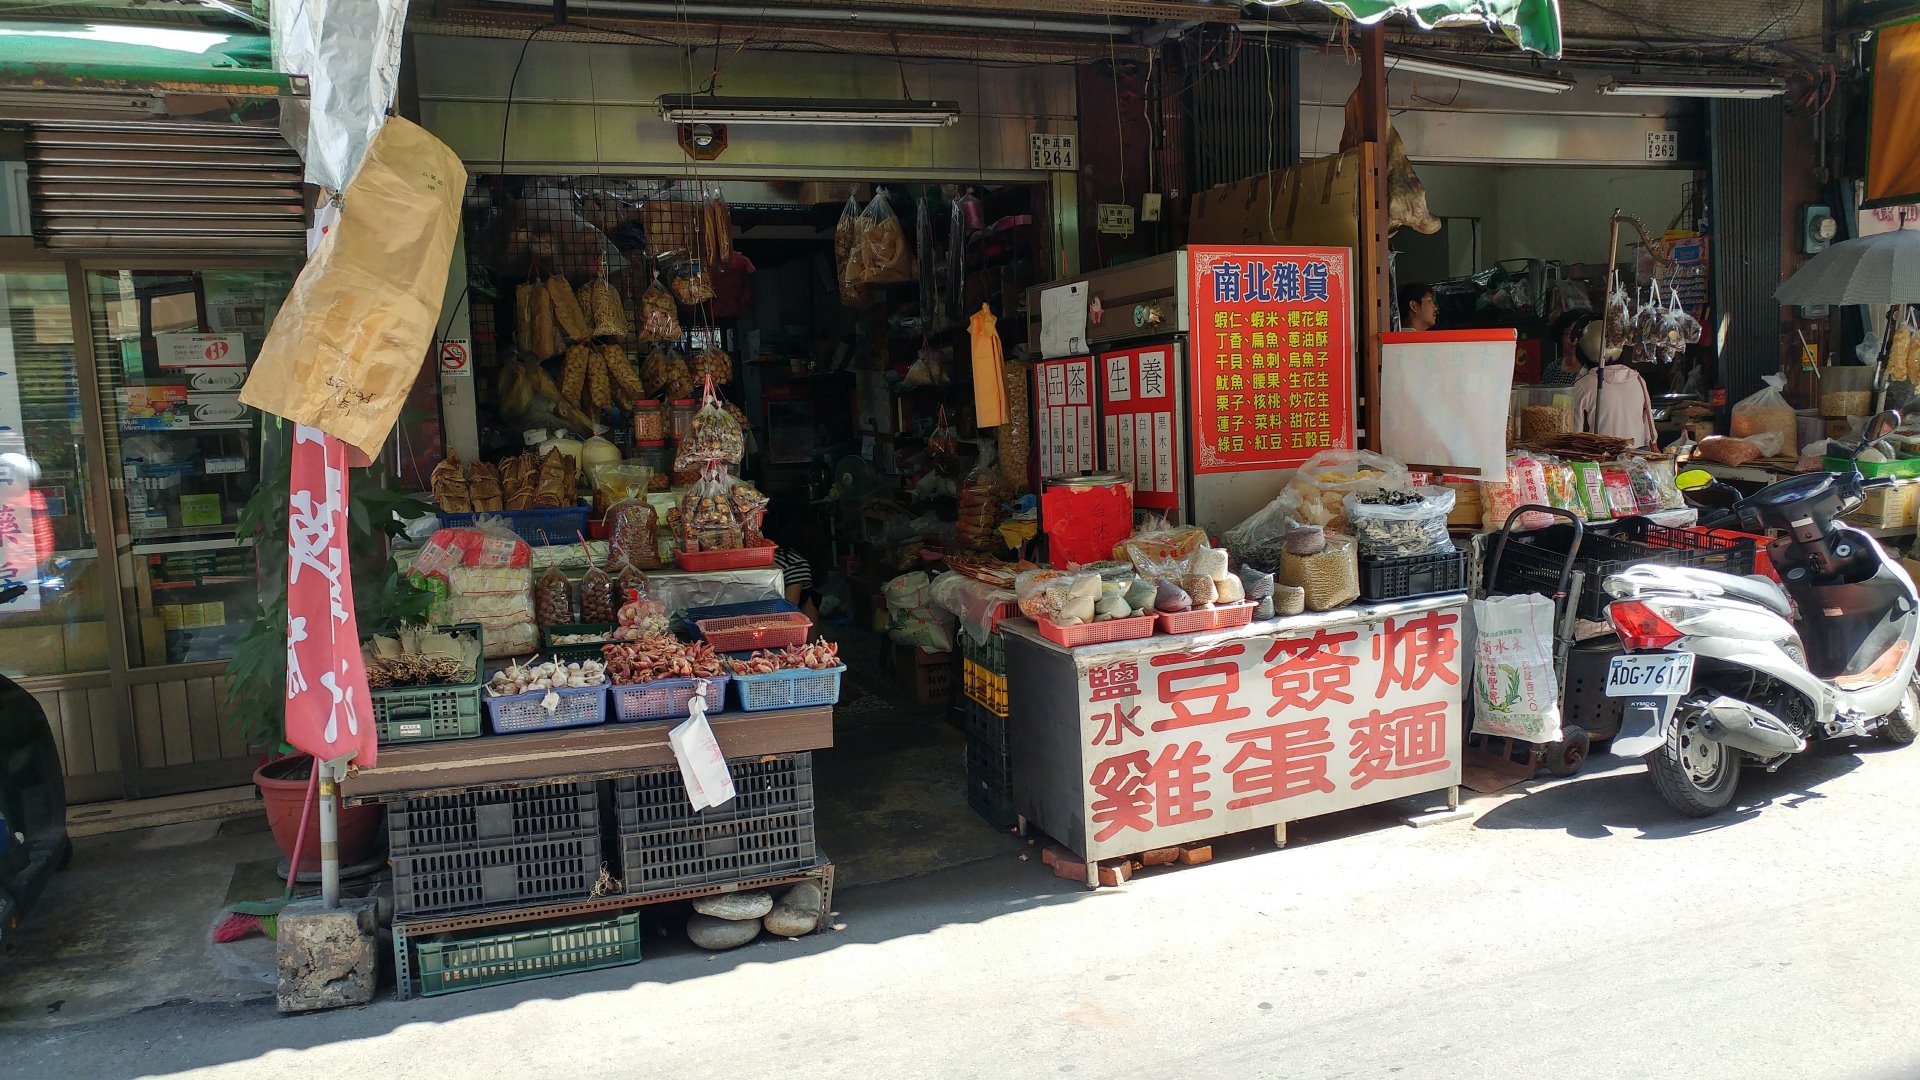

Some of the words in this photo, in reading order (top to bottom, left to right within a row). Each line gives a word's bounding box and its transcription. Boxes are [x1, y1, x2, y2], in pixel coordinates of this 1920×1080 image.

[1043, 150, 1072, 167] 264
[1654, 144, 1675, 157] 262
[1212, 261, 1330, 303] 南北雜貨
[1139, 417, 1149, 486] 白木耳茶
[1158, 416, 1168, 486] 黑木耳茶
